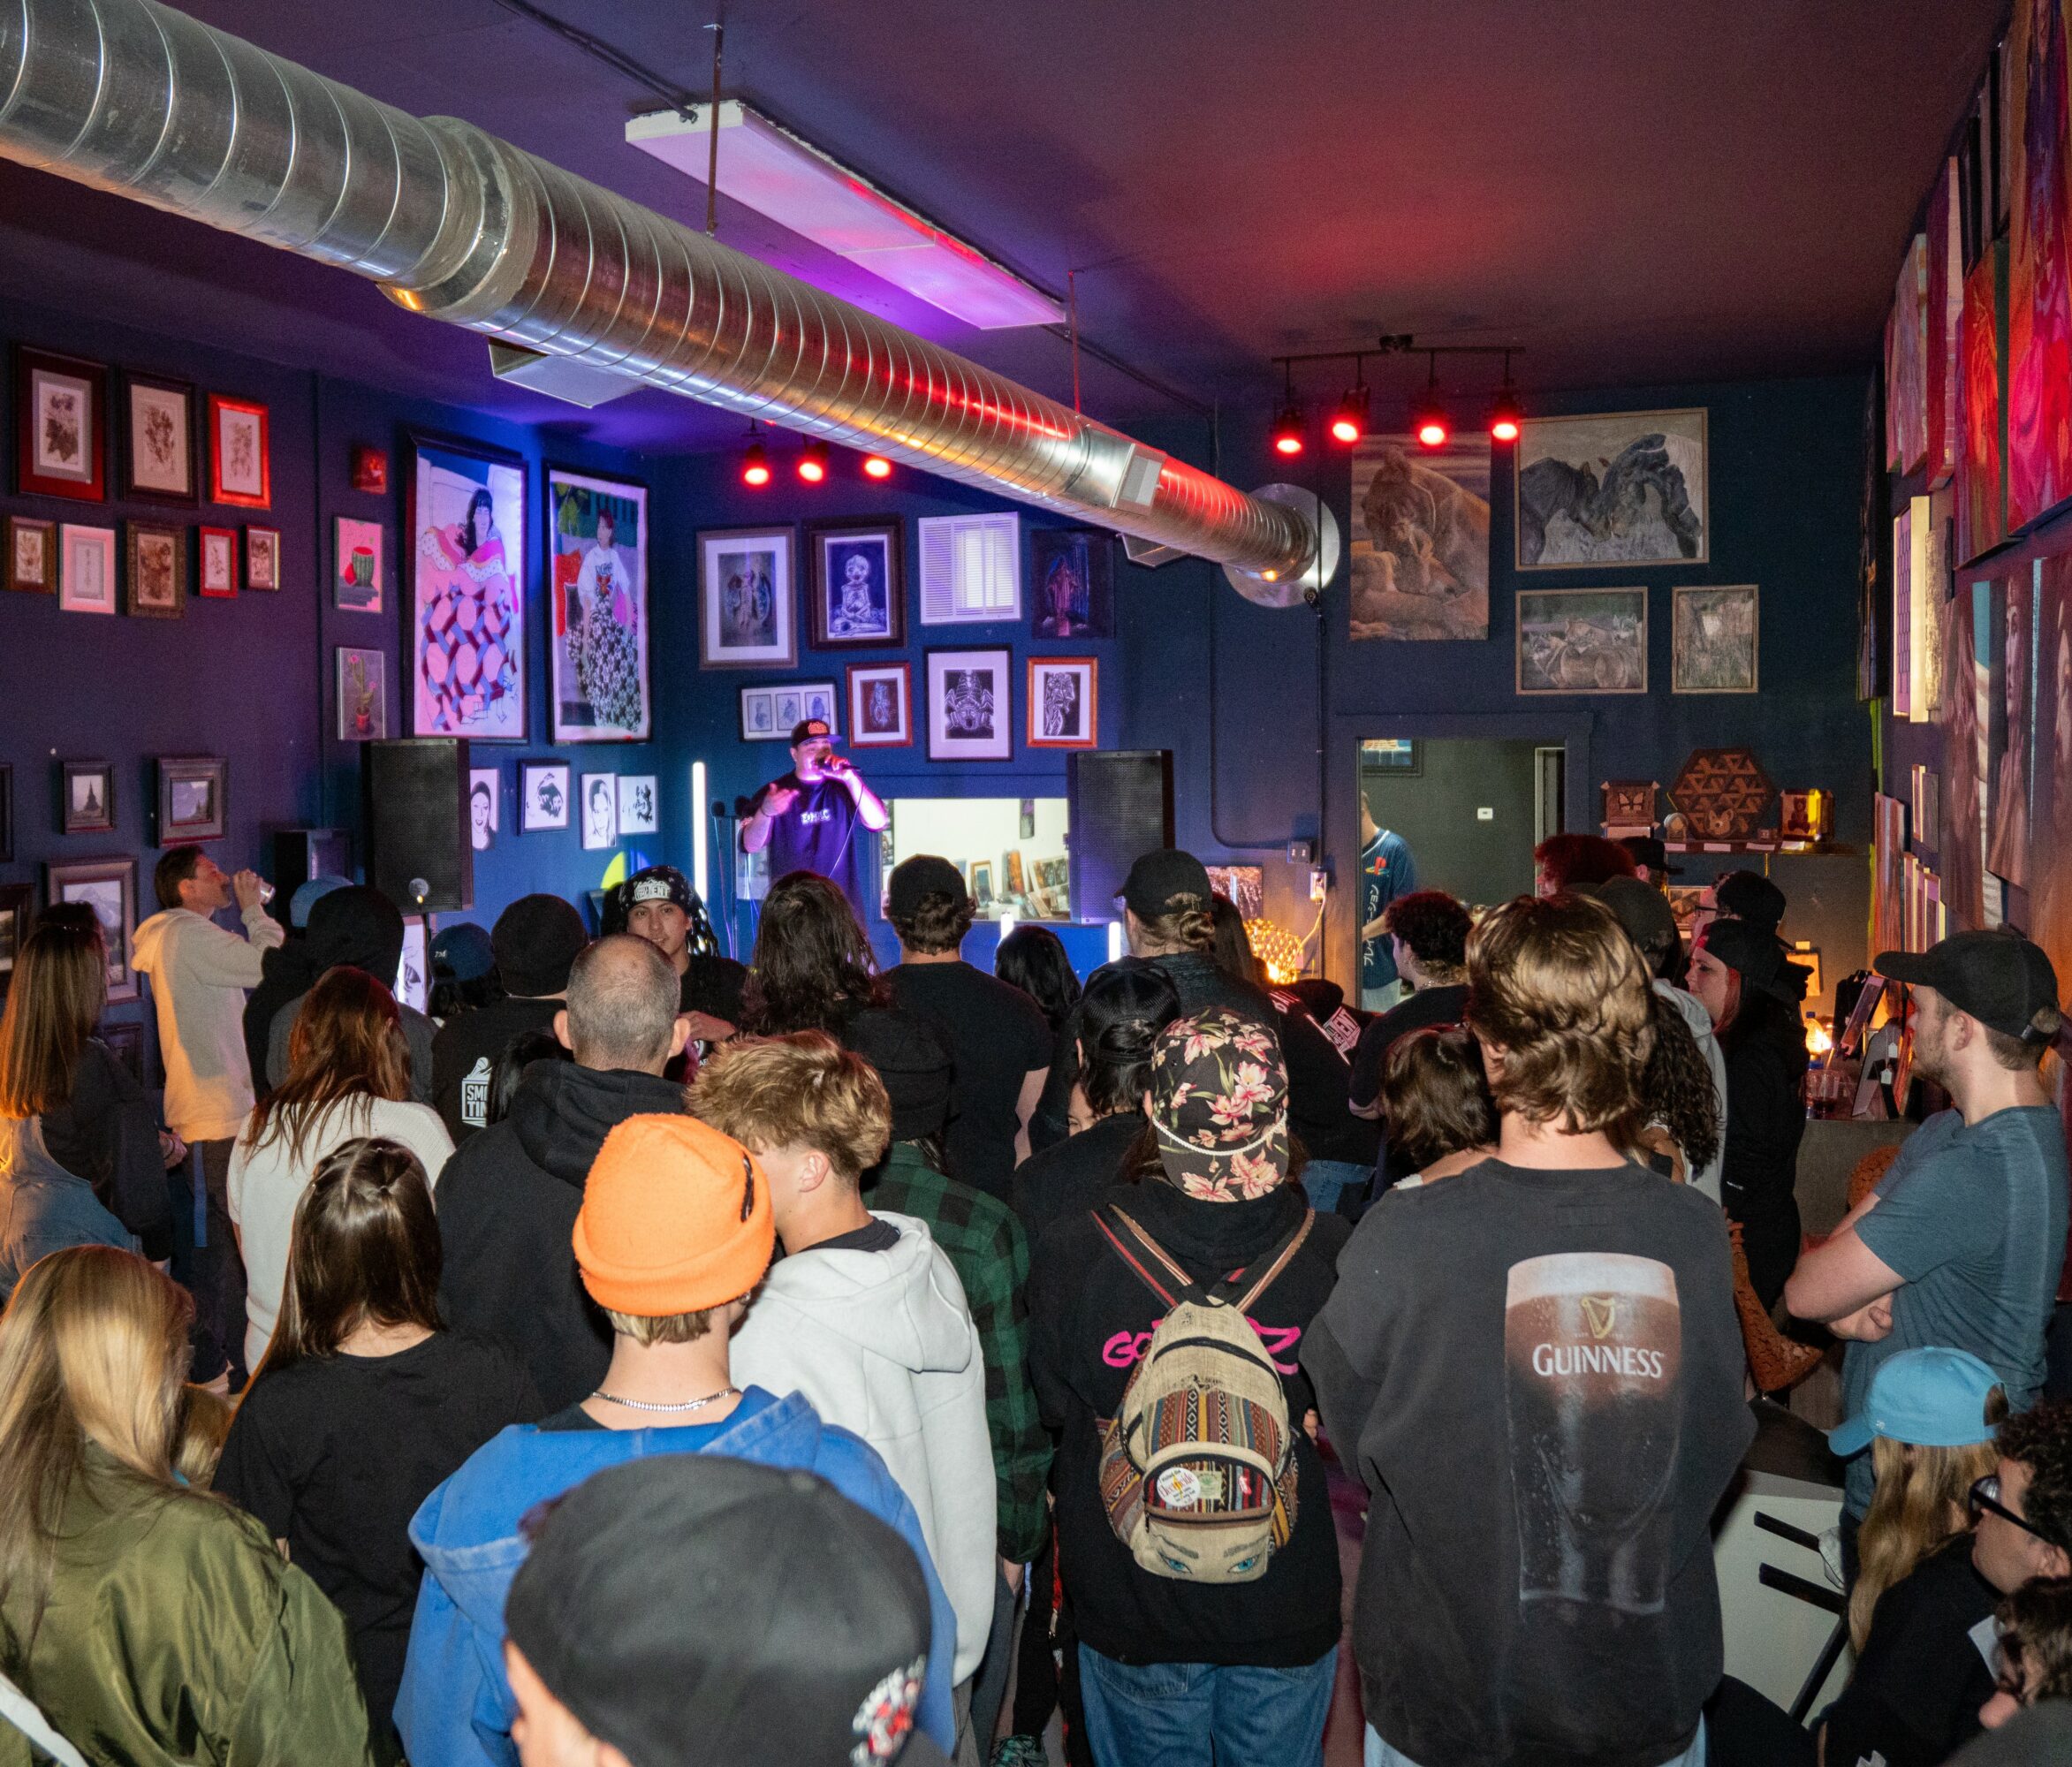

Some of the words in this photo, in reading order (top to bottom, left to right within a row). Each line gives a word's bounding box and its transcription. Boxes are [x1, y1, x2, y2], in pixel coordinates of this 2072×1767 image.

[1363, 884, 1379, 967] プレイーション
[1532, 1343, 1664, 1379] GUINNESS
